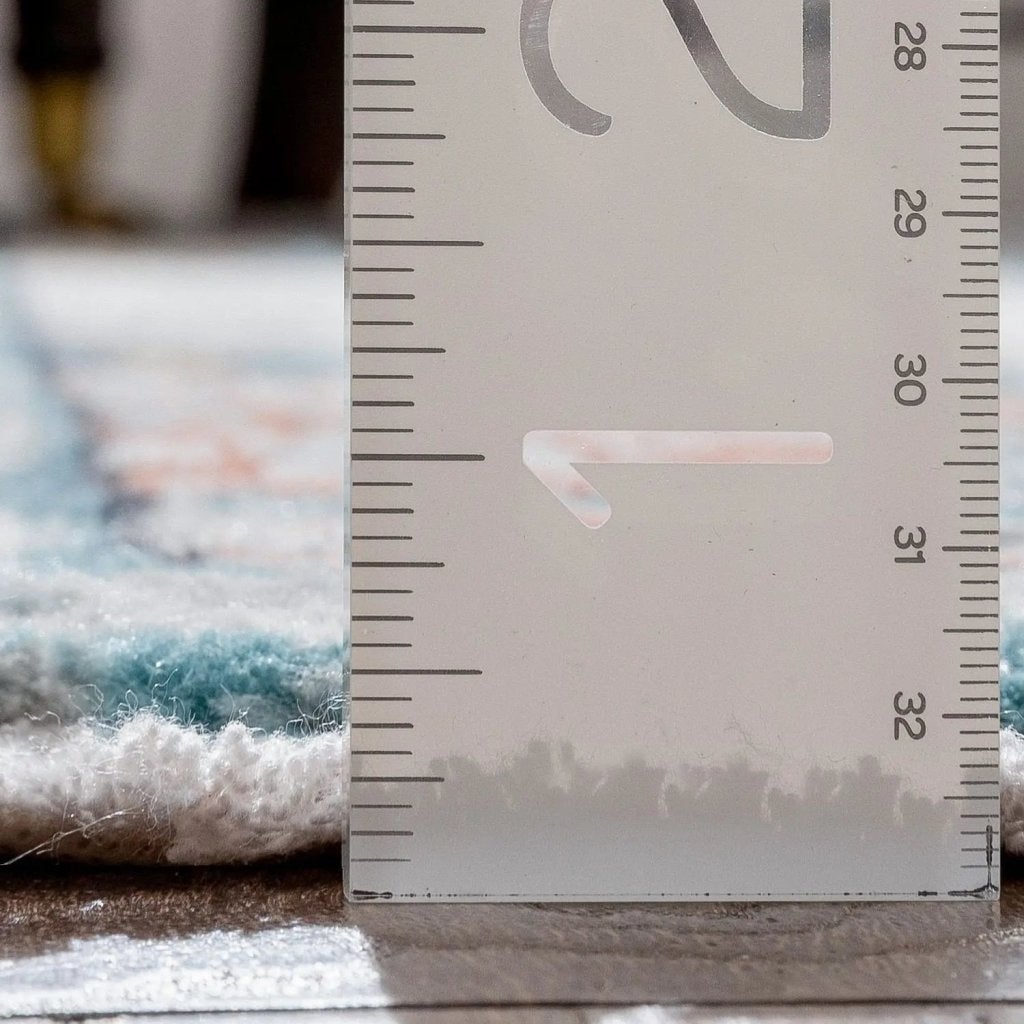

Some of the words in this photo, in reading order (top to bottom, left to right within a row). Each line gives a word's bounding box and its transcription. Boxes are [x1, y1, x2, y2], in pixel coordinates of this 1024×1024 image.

[893, 21, 928, 73] 28
[893, 187, 928, 240] 29
[893, 353, 928, 408] 30
[521, 429, 834, 530] 1
[893, 525, 928, 565] 31
[893, 691, 928, 742] 32
